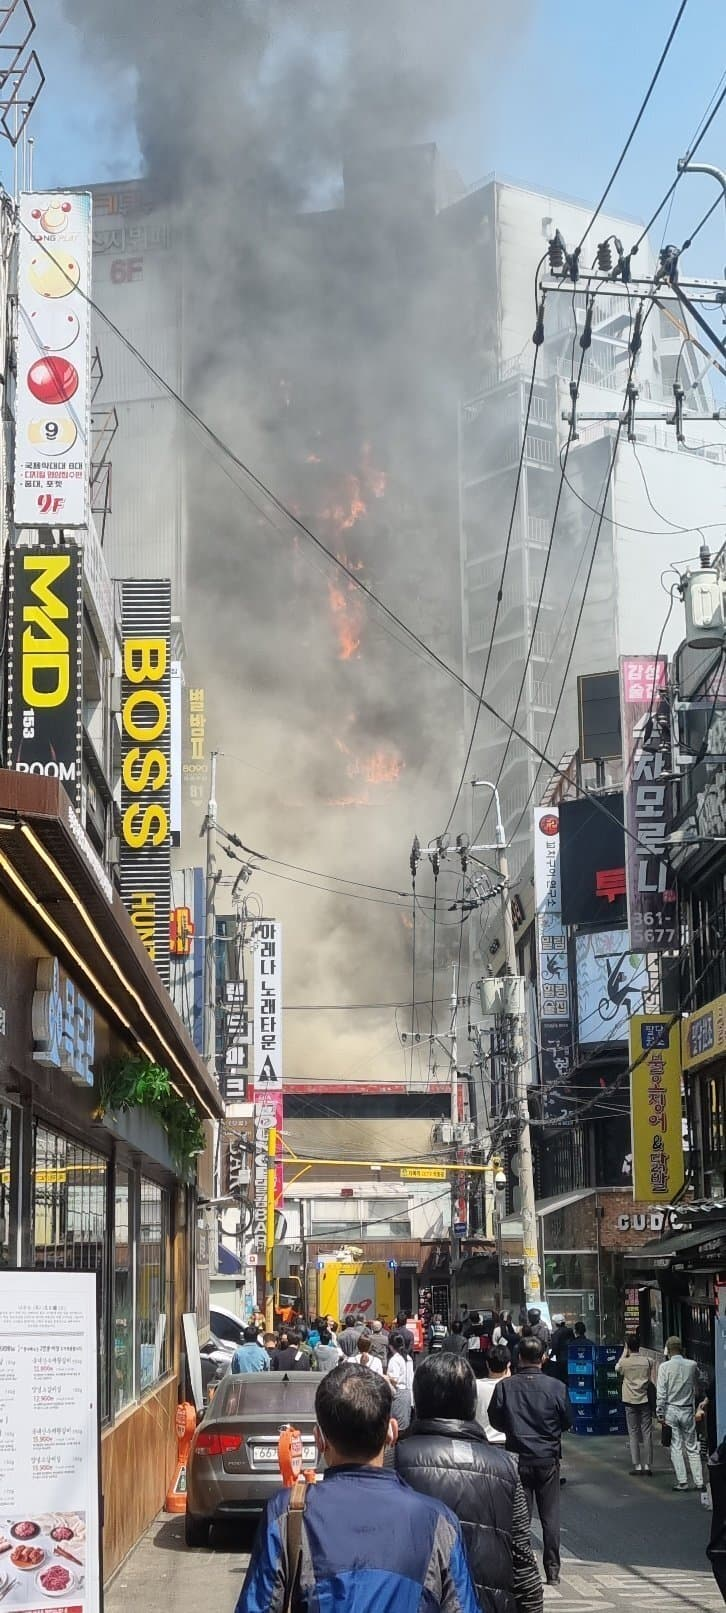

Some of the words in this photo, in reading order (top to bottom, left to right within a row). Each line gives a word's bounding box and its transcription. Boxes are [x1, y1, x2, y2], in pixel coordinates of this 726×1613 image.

[111, 257, 143, 284] 6F
[38, 494, 64, 513] 9F
[22, 555, 71, 708] MAD
[628, 664, 661, 680] 감성
[22, 708, 35, 738] 153
[122, 639, 168, 849] BOSS
[633, 928, 675, 943] 5677
[542, 983, 567, 998] 힐링
[261, 981, 277, 1051] 노래타운
[542, 1000, 568, 1015] 술집
[343, 1298, 373, 1314] 119
